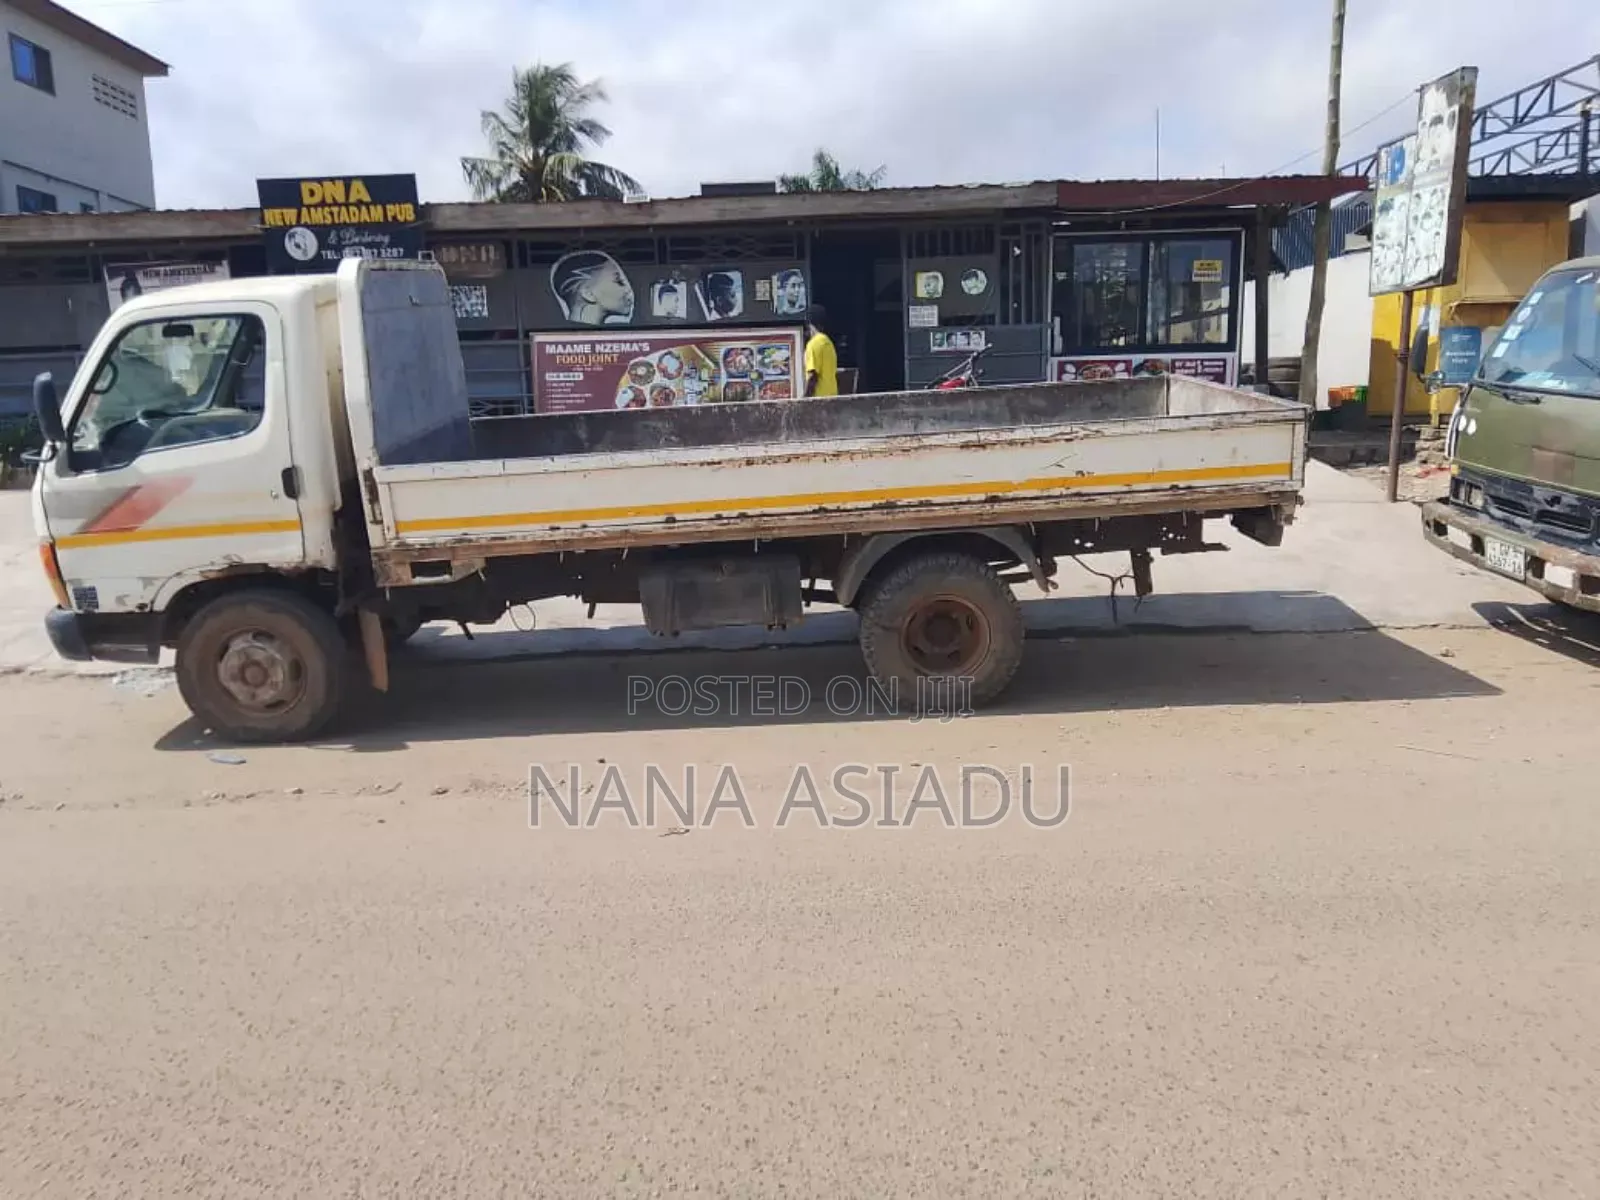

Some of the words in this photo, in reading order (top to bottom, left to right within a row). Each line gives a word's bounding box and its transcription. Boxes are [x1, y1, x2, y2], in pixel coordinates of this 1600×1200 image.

[301, 179, 372, 205] DNA
[264, 208, 298, 227] NEW
[300, 203, 384, 225] AMSTADAM
[386, 202, 416, 222] PUB
[545, 344, 592, 355] MAAME
[595, 342, 650, 354] NZEMA'S
[556, 354, 586, 365] FOOD
[587, 353, 619, 366] JOINT
